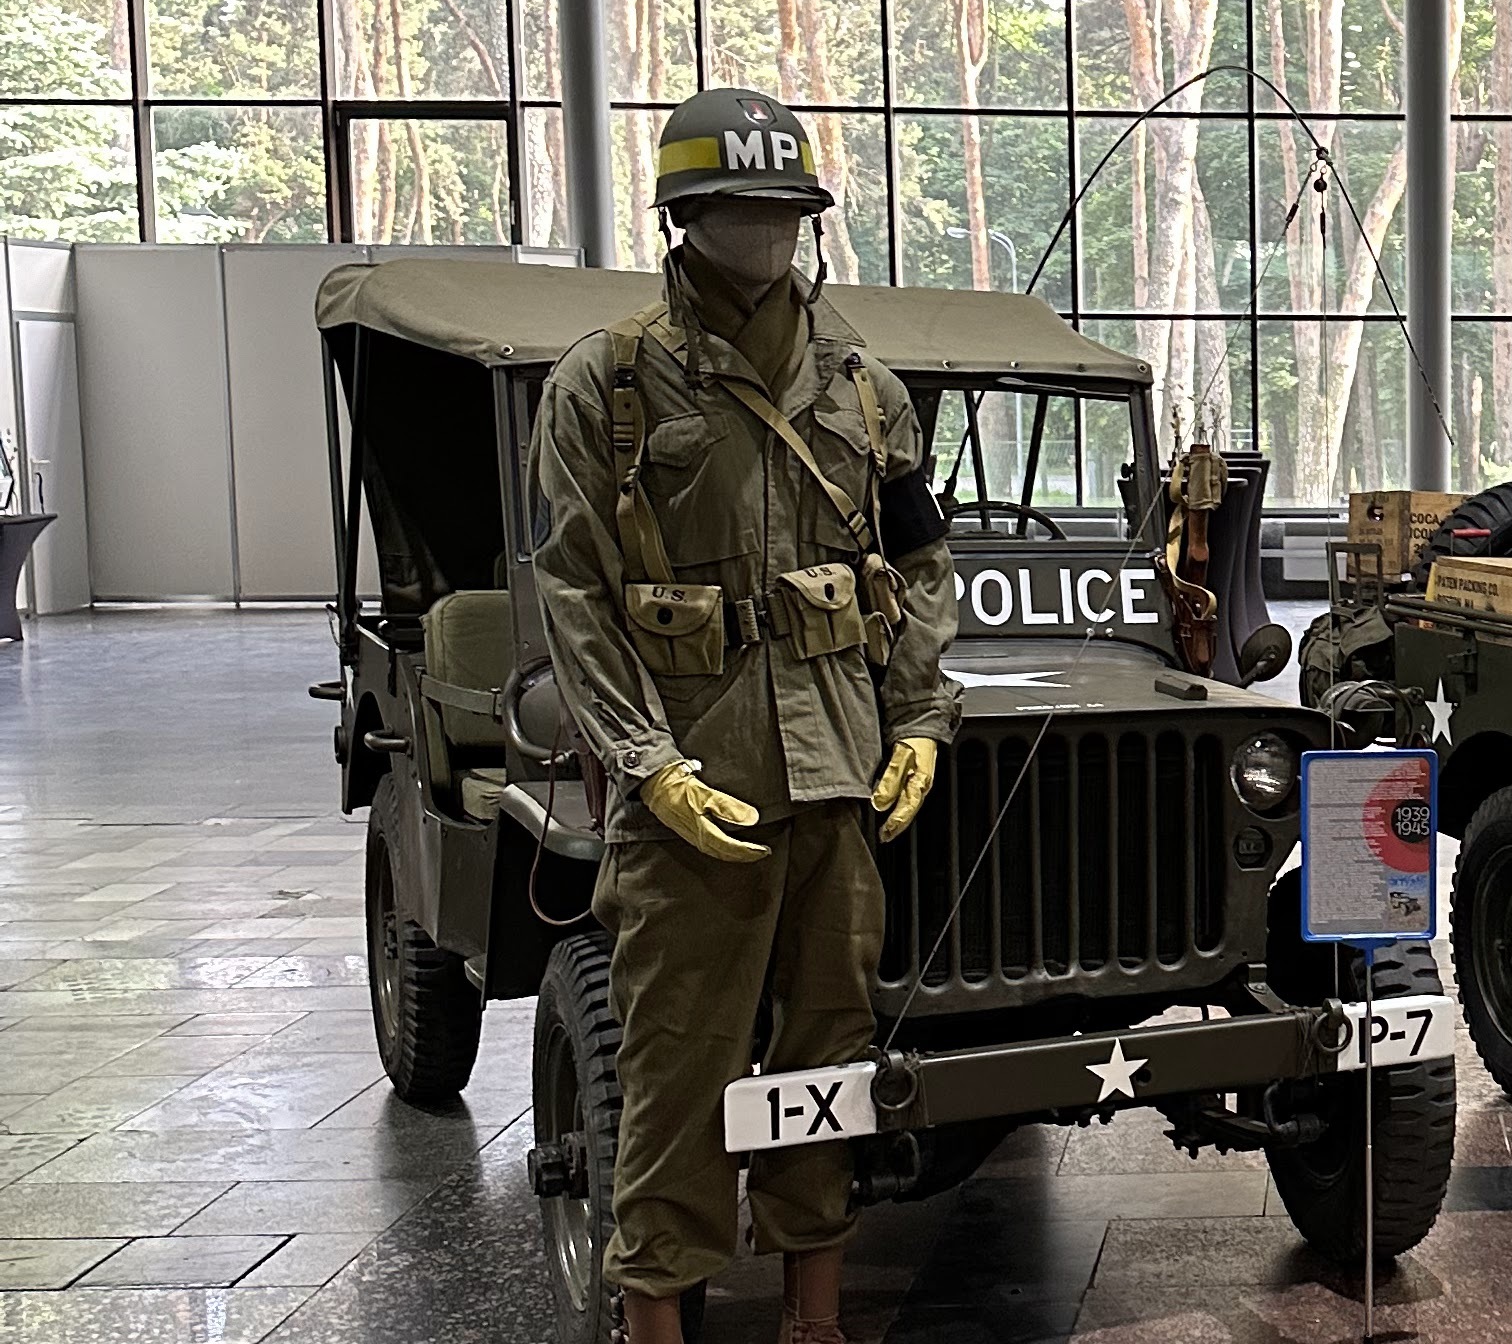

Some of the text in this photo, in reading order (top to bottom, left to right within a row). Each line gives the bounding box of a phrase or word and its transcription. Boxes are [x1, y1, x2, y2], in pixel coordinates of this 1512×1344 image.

[724, 130, 799, 171] MP
[652, 586, 688, 604] U.S.
[954, 568, 1159, 626] OLICE
[1395, 807, 1430, 822] 1939
[1395, 821, 1430, 836] 1945
[766, 1081, 844, 1141] 1-X
